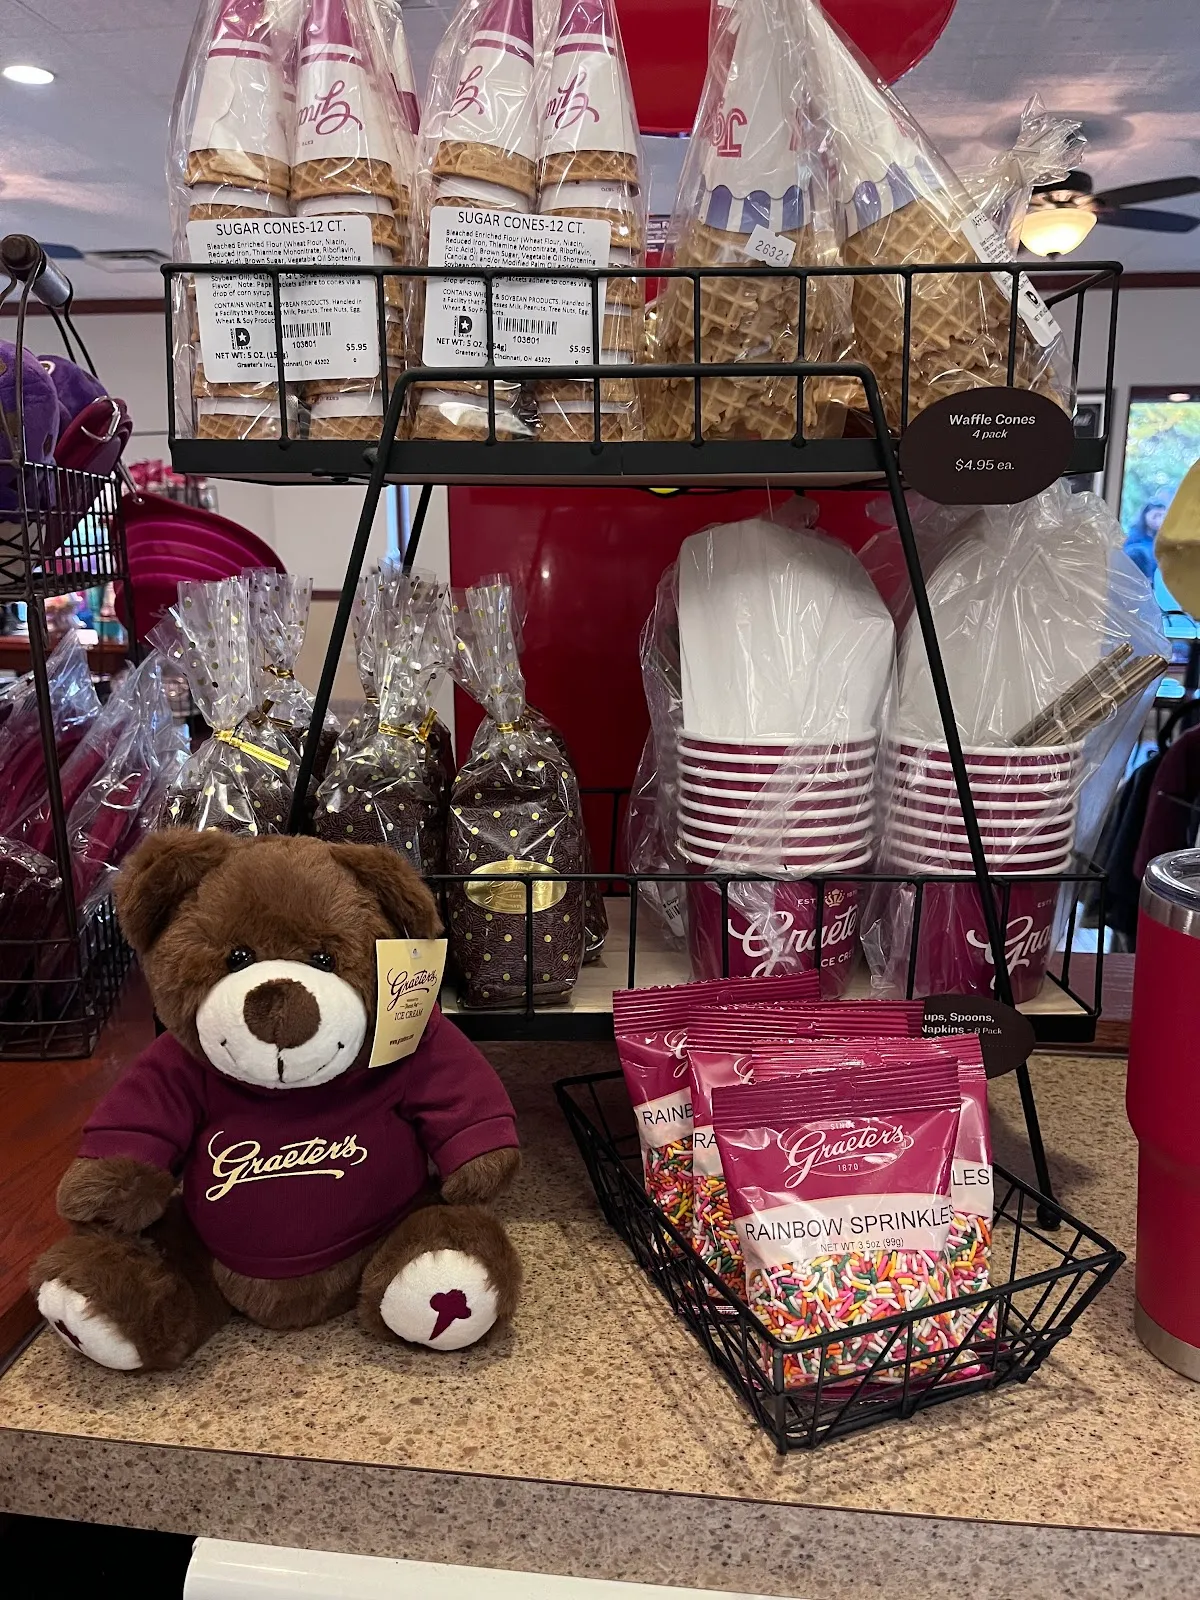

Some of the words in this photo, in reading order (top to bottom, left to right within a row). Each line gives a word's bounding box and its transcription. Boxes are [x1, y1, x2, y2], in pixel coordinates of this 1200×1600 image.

[216, 222, 260, 236] SUGAR
[264, 221, 323, 234] CONES-12
[328, 220, 346, 232] CT.
[458, 212, 500, 226] SUGAR
[504, 216, 564, 232] CONES-12
[568, 222, 585, 234] CT.
[476, 231, 501, 240] Enriched
[564, 239, 584, 248] Niacin,
[207, 242, 235, 250] Bleached
[490, 241, 516, 250] Thiamine
[519, 244, 557, 253] Mononitrate,
[560, 247, 591, 257] Riboflavin,
[288, 256, 315, 264] Vegetable
[501, 251, 520, 259] Sugar,
[564, 256, 596, 266] Shortening
[443, 288, 472, 297] CONTAINS
[346, 343, 368, 351] $5.95
[569, 345, 590, 354] $5.95
[949, 414, 992, 425] Waffle
[995, 414, 1036, 425] Cones
[972, 430, 980, 438] 4
[982, 429, 1008, 440] pack
[955, 459, 994, 471] $4.95
[997, 461, 1015, 470] ea.
[821, 956, 835, 968] CE
[394, 1011, 404, 1020] ICE
[405, 1008, 423, 1020] CREAM
[924, 1014, 947, 1026] ups,
[950, 1013, 994, 1026] Spoons,
[982, 1026, 1002, 1035] Pack
[777, 1125, 914, 1188] Graeter's
[206, 1130, 368, 1201] Graeter's
[837, 1163, 859, 1172] 1870
[745, 1218, 843, 1241] RAINBOW
[850, 1204, 955, 1234] SPRINKLES
[820, 1243, 840, 1252] NET
[841, 1242, 855, 1251] WT
[883, 1237, 904, 1248] (99g)
